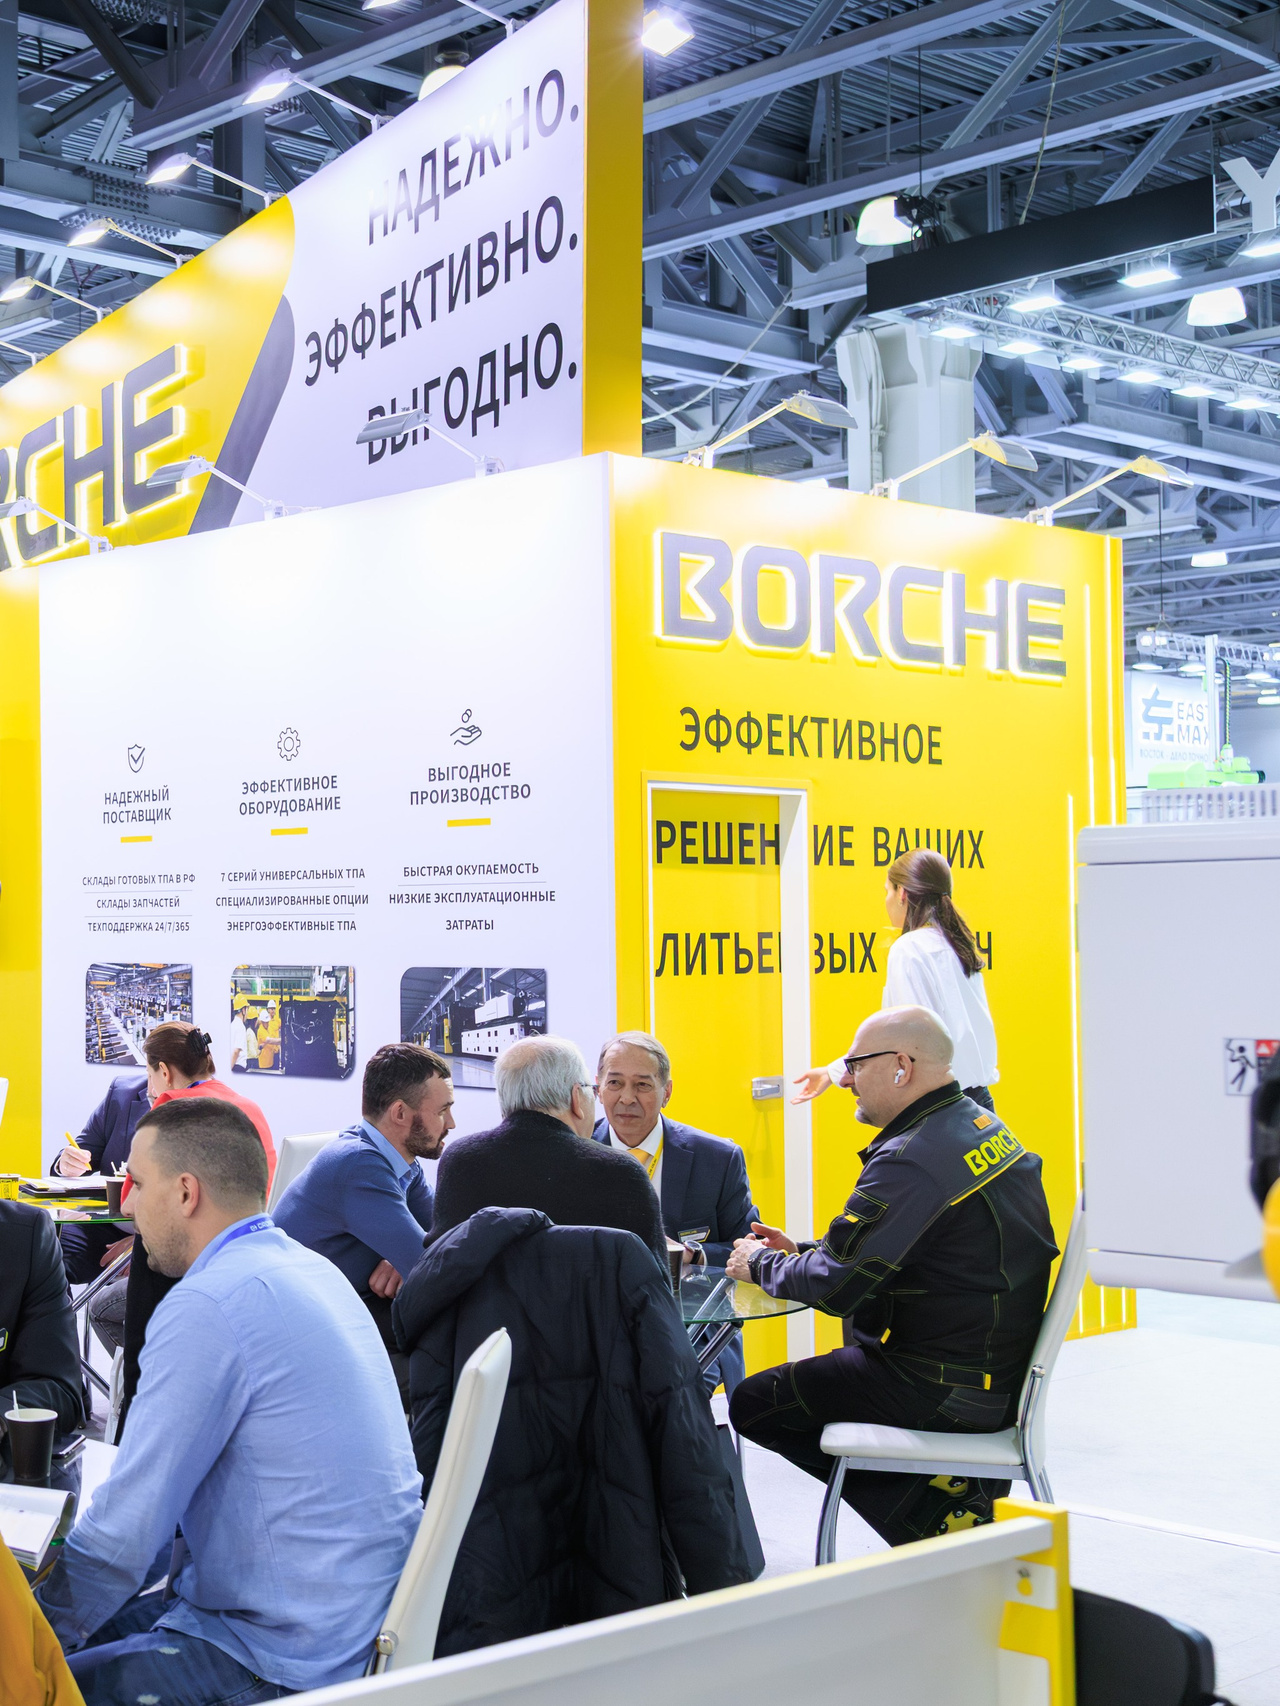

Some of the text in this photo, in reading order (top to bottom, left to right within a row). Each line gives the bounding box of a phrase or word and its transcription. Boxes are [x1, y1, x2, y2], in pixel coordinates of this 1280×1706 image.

[368, 68, 580, 247] НАДЕЖНО.
[304, 195, 578, 387] ЭФФЕКТИВНО.
[368, 322, 577, 465] ВЫГОДНО.
[660, 531, 1067, 677] BORCHE
[1177, 702, 1209, 722] EAS
[679, 706, 943, 766] ЭФФЕКТИВНОЕ
[428, 762, 511, 783] ВЫГОДНОЕ
[241, 775, 338, 795] ЭФФЕКТИВНОЕ
[410, 783, 531, 805] ПРОИЗВОДСТВО
[104, 785, 170, 807] НАДЕЖНЫЙ
[103, 807, 172, 824] ПОСТАВЩИК
[239, 796, 341, 817] ОБОРУДОВАНИЕ
[220, 868, 366, 882] 7 СЕРИЙ УНИВЕРСАЛЬНЫХ ТПА
[403, 862, 540, 877] БЫСТРАЯ ОКУПАЕМОСТЬ
[82, 873, 196, 887] СКЛАДЫ ГОТОВЫХ ТПА В РФ
[96, 896, 180, 910] СКЛАДЫ ЗАПЧАСТЕЙ
[215, 894, 369, 908] СПЕЦИАЛИЗИРОВАННЫЕ ОПЦИИ
[389, 890, 556, 905] НИЗКИЕ ЭКСПЛУАТАЦИОННЫЕ
[88, 921, 190, 933] ТЕХПОДДЕРЖКА 24/7/365
[227, 920, 357, 932] ЭНЕРГОЭФФЕКТИВНЫЕ ТПА
[445, 919, 494, 931] ЗАТРАТЫ
[963, 1128, 1019, 1176] BORCH
